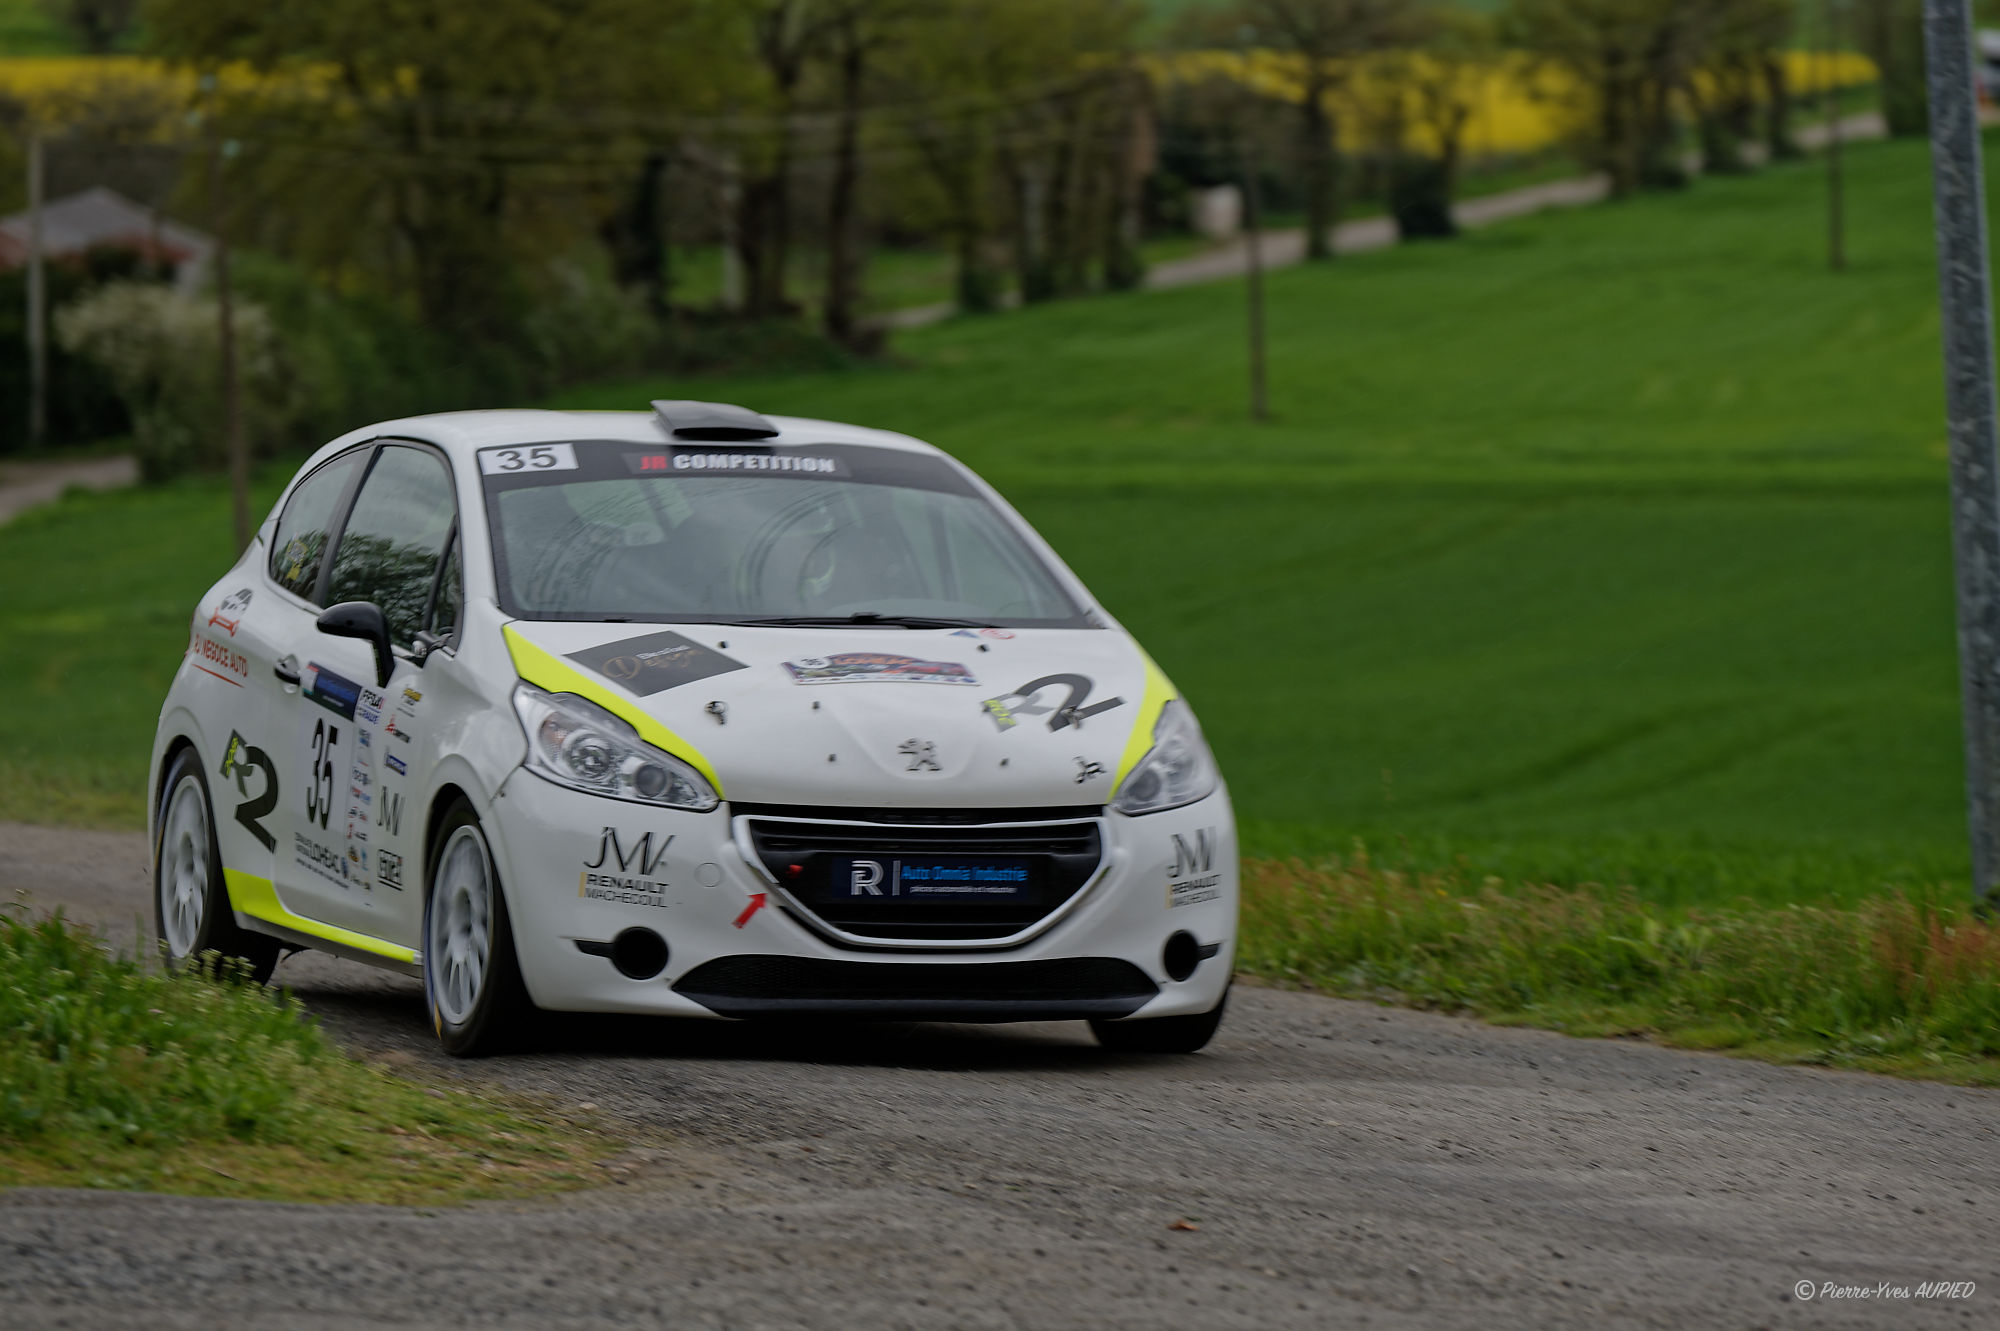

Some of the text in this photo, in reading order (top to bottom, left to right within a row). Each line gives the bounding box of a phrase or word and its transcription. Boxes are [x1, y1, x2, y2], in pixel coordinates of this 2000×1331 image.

[495, 446, 558, 471] 35
[640, 454, 837, 473] JR COMPETITION
[306, 717, 339, 831] 35
[586, 873, 670, 895] RENAULT
